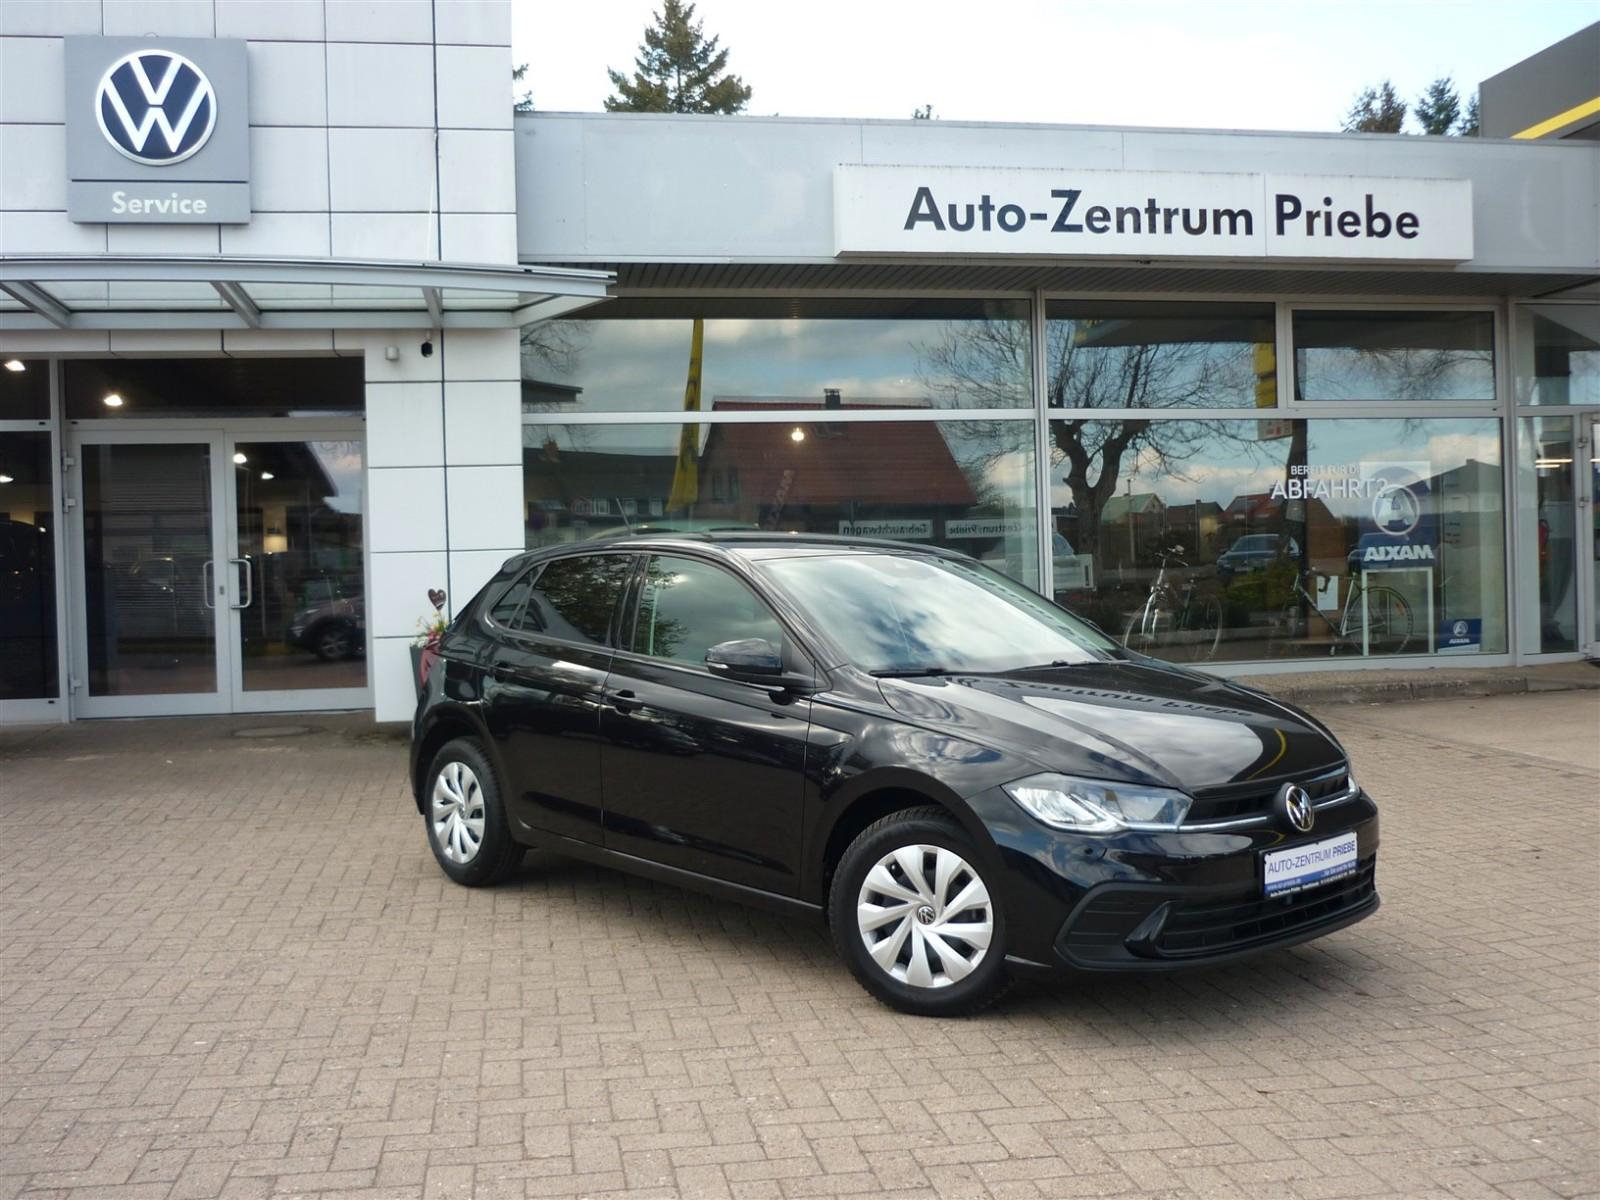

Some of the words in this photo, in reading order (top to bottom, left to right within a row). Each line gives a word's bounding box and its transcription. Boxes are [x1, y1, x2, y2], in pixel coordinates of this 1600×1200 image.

[112, 191, 208, 214] Service
[904, 186, 1254, 236] Auto-Zentrum
[1275, 193, 1420, 240] Priebe
[1271, 479, 1387, 500] ABFAHRT?
[1363, 544, 1435, 562] AIXAM
[1267, 848, 1331, 874] AUTO-ZENTRUM
[1332, 840, 1355, 858] PRIEBE
